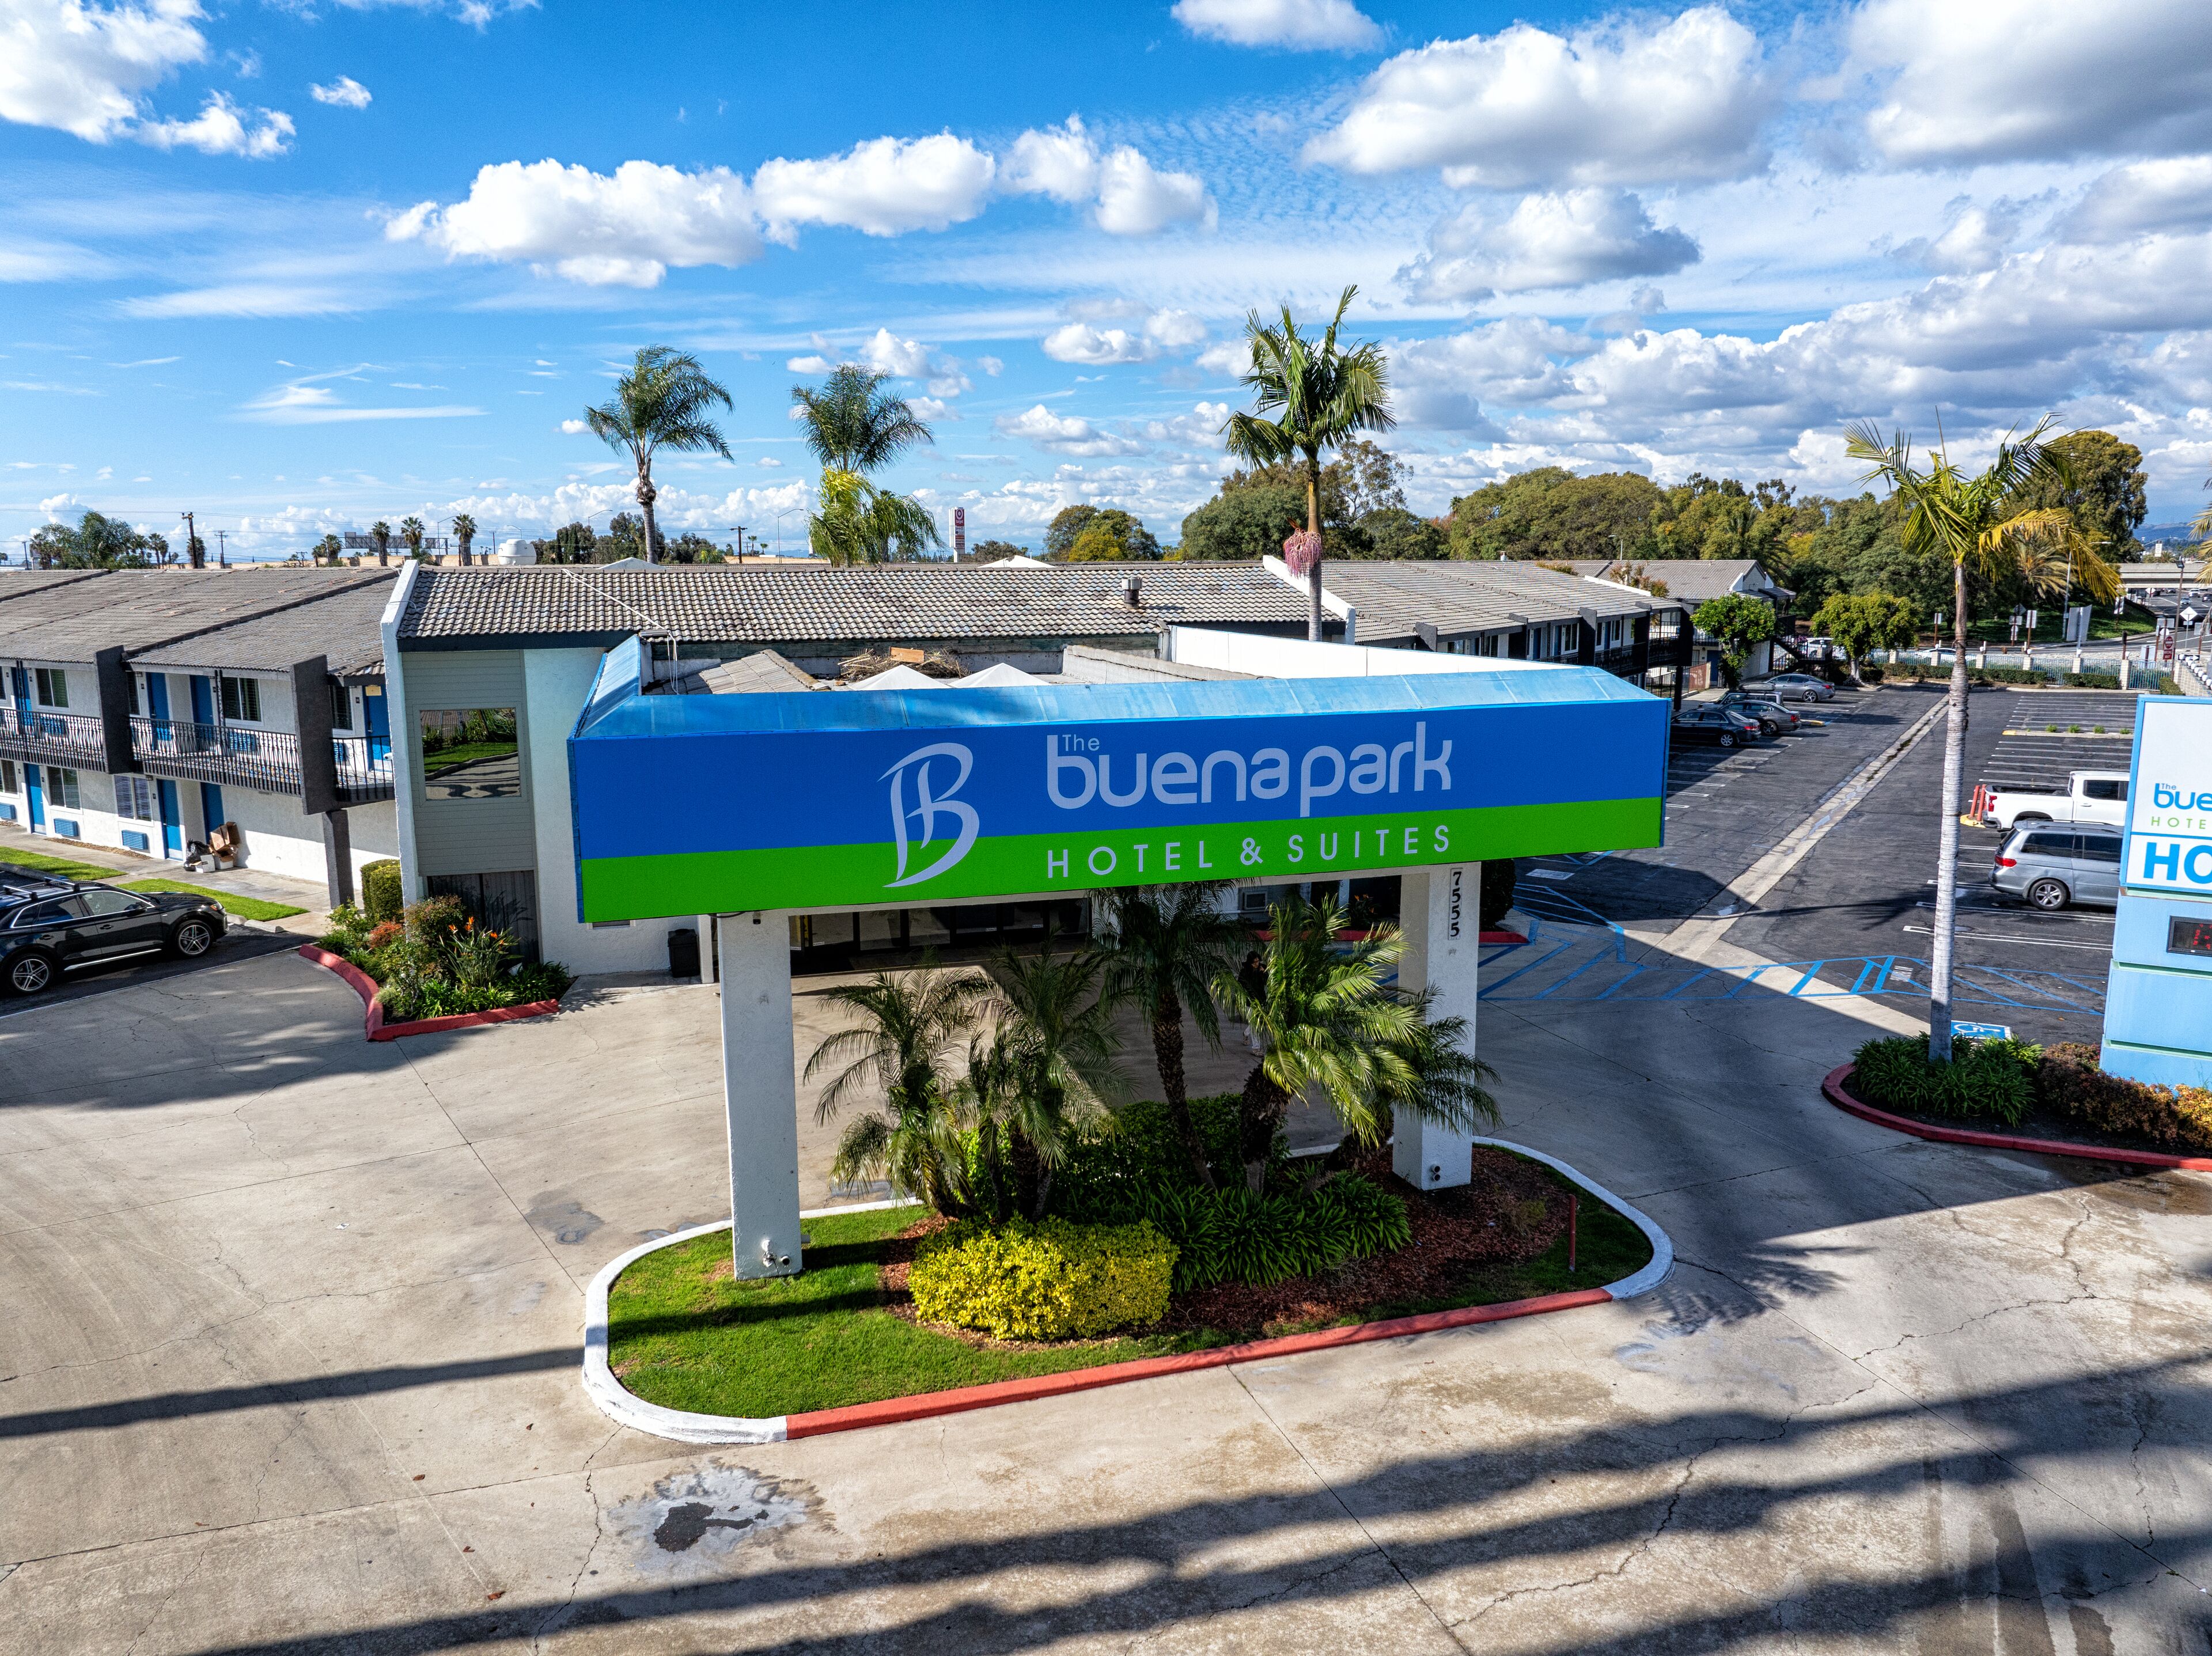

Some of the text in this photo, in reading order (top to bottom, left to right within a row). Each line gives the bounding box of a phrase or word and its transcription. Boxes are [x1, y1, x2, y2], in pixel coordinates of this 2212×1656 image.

[1062, 734, 1100, 752] The
[1048, 825, 1449, 878] HOTEL & SUITES
[1450, 871, 1462, 937] 7555
